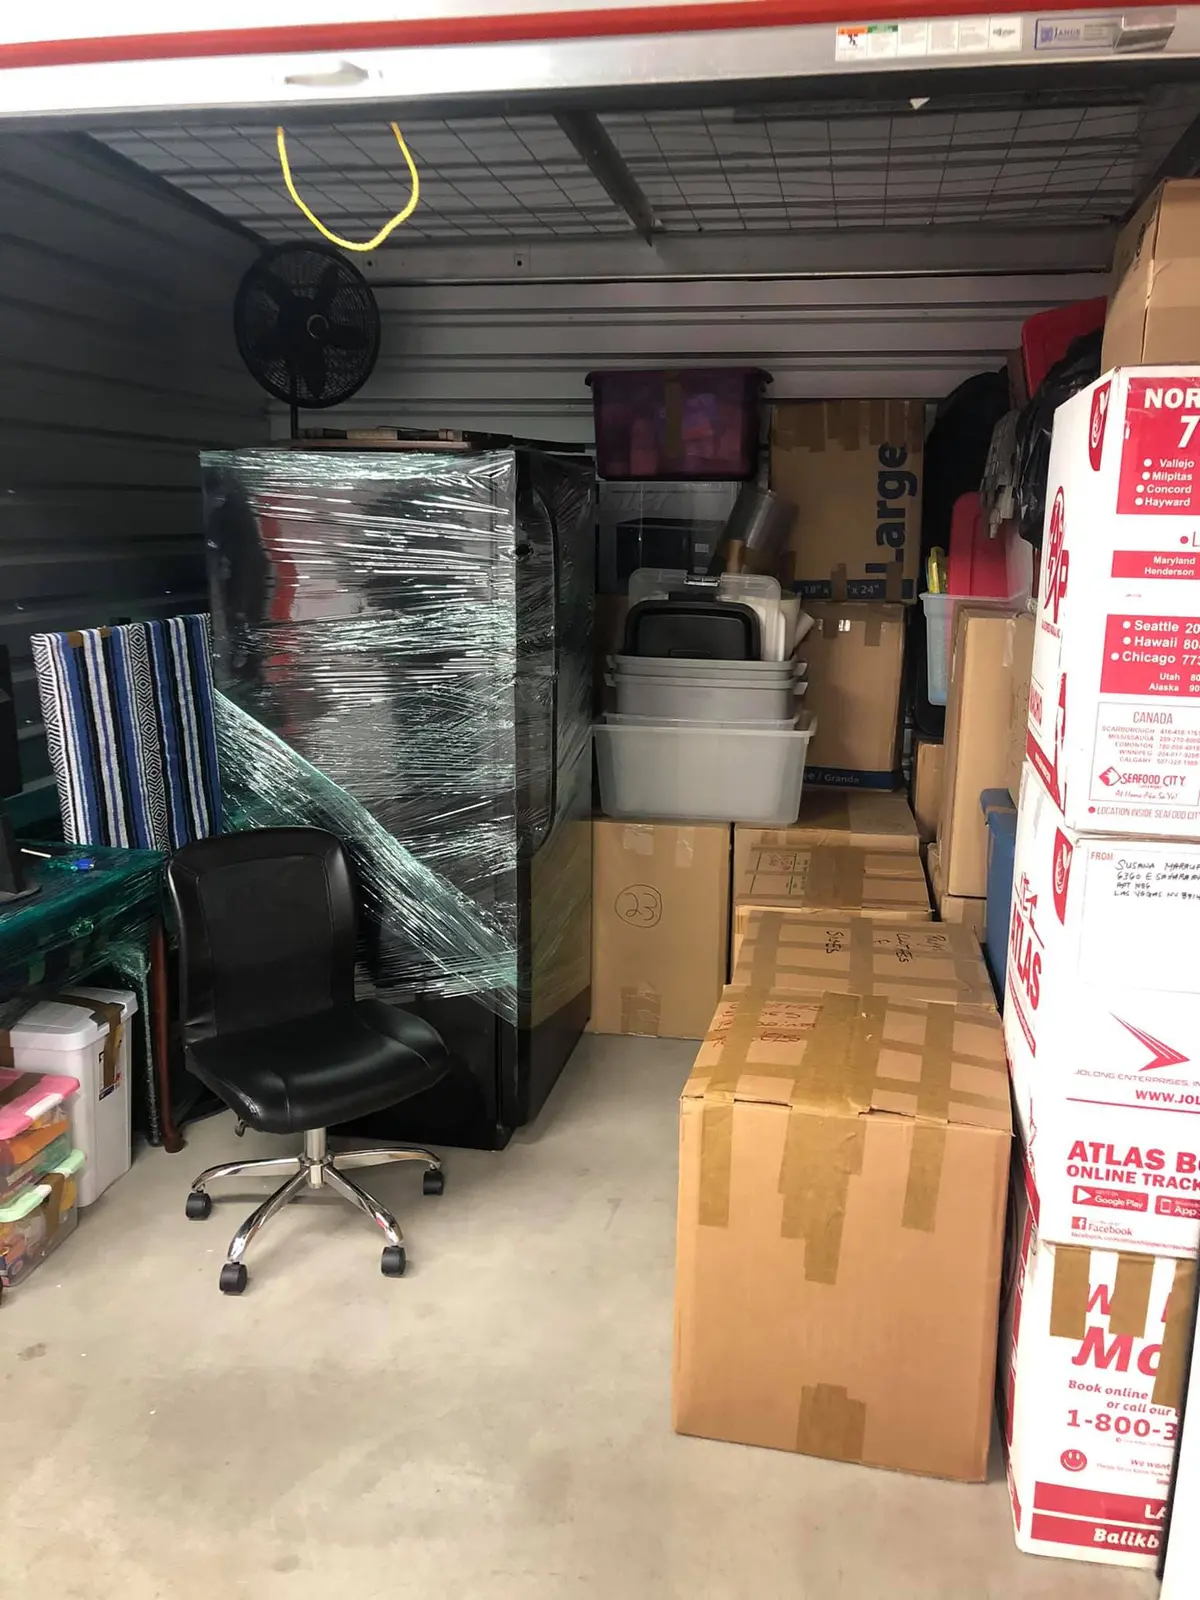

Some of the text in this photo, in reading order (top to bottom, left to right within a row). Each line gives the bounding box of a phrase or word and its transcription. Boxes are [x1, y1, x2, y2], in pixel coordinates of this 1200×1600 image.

[1159, 458, 1195, 470] Vallejo
[1151, 471, 1193, 482] Milpitas
[1146, 485, 1192, 494] Concord
[865, 441, 918, 574] Large
[1144, 497, 1191, 508] Hayward
[1153, 556, 1196, 566] Maryland
[1144, 567, 1195, 576] Henderson
[1134, 620, 1179, 632] Seattle
[1134, 636, 1200, 650] Hawaii 80
[1122, 651, 1176, 666] Chicago
[1159, 672, 1180, 681] Utah
[1149, 682, 1179, 692] Alaska
[1132, 711, 1173, 725] CANADA
[1102, 725, 1155, 734] SCARBOROUGH
[1108, 733, 1154, 742] MISSISSAUGA
[1115, 741, 1153, 749] EDMONTON
[1120, 773, 1161, 785] SEAFOOD
[1162, 775, 1186, 787] CITY
[1096, 806, 1130, 816] LOCATION
[1131, 808, 1152, 818] INSIDE
[1154, 809, 1186, 820] SEAFOOD
[1090, 851, 1113, 861] FROM
[625, 891, 659, 921] 23
[1010, 903, 1041, 1010] ATLAS
[1074, 1068, 1115, 1080] JOLONG
[1067, 1140, 1200, 1175] ATLAS B
[1066, 1164, 1137, 1185] ONLINE
[1094, 1194, 1197, 1216] Google Play App
[1088, 1222, 1133, 1236] Facebook
[1068, 1379, 1149, 1400] Book online
[1106, 1400, 1120, 1410] or
[1123, 1402, 1147, 1413] call
[1149, 1406, 1172, 1416] our
[1066, 1409, 1178, 1441] 1-800-3
[1147, 1461, 1171, 1471] want
[1093, 1527, 1160, 1549] Balikb
